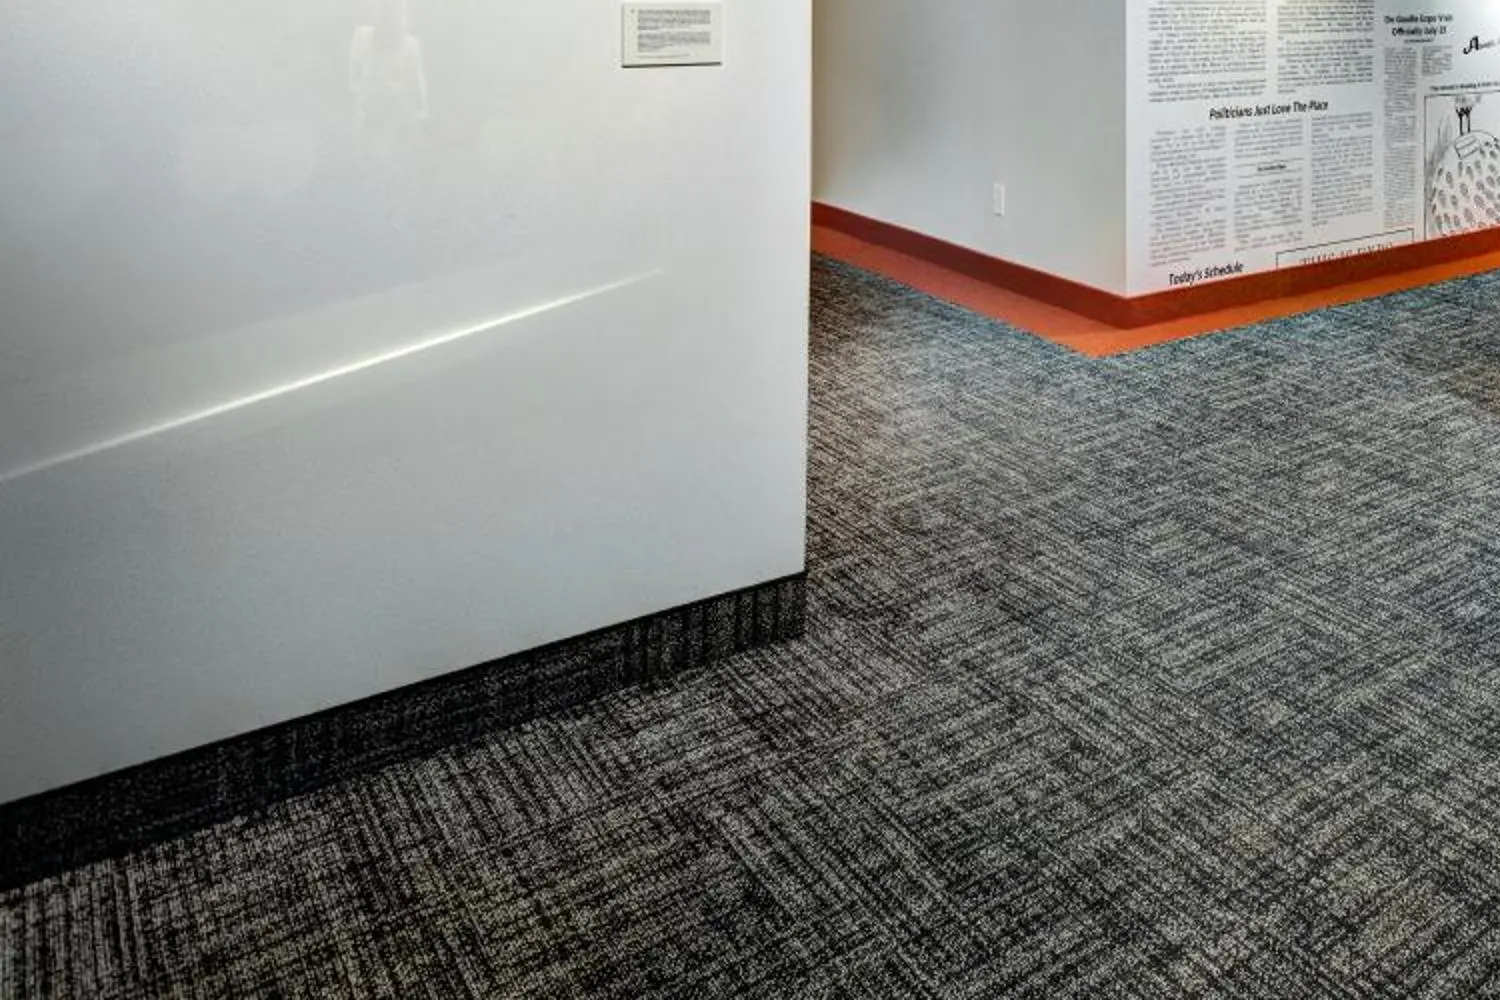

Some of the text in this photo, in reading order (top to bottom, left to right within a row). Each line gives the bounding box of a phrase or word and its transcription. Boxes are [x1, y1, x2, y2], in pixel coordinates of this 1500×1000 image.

[1209, 105, 1253, 120] Politicians
[1292, 100, 1307, 113] The
[1168, 261, 1245, 287] Today's Schedule
